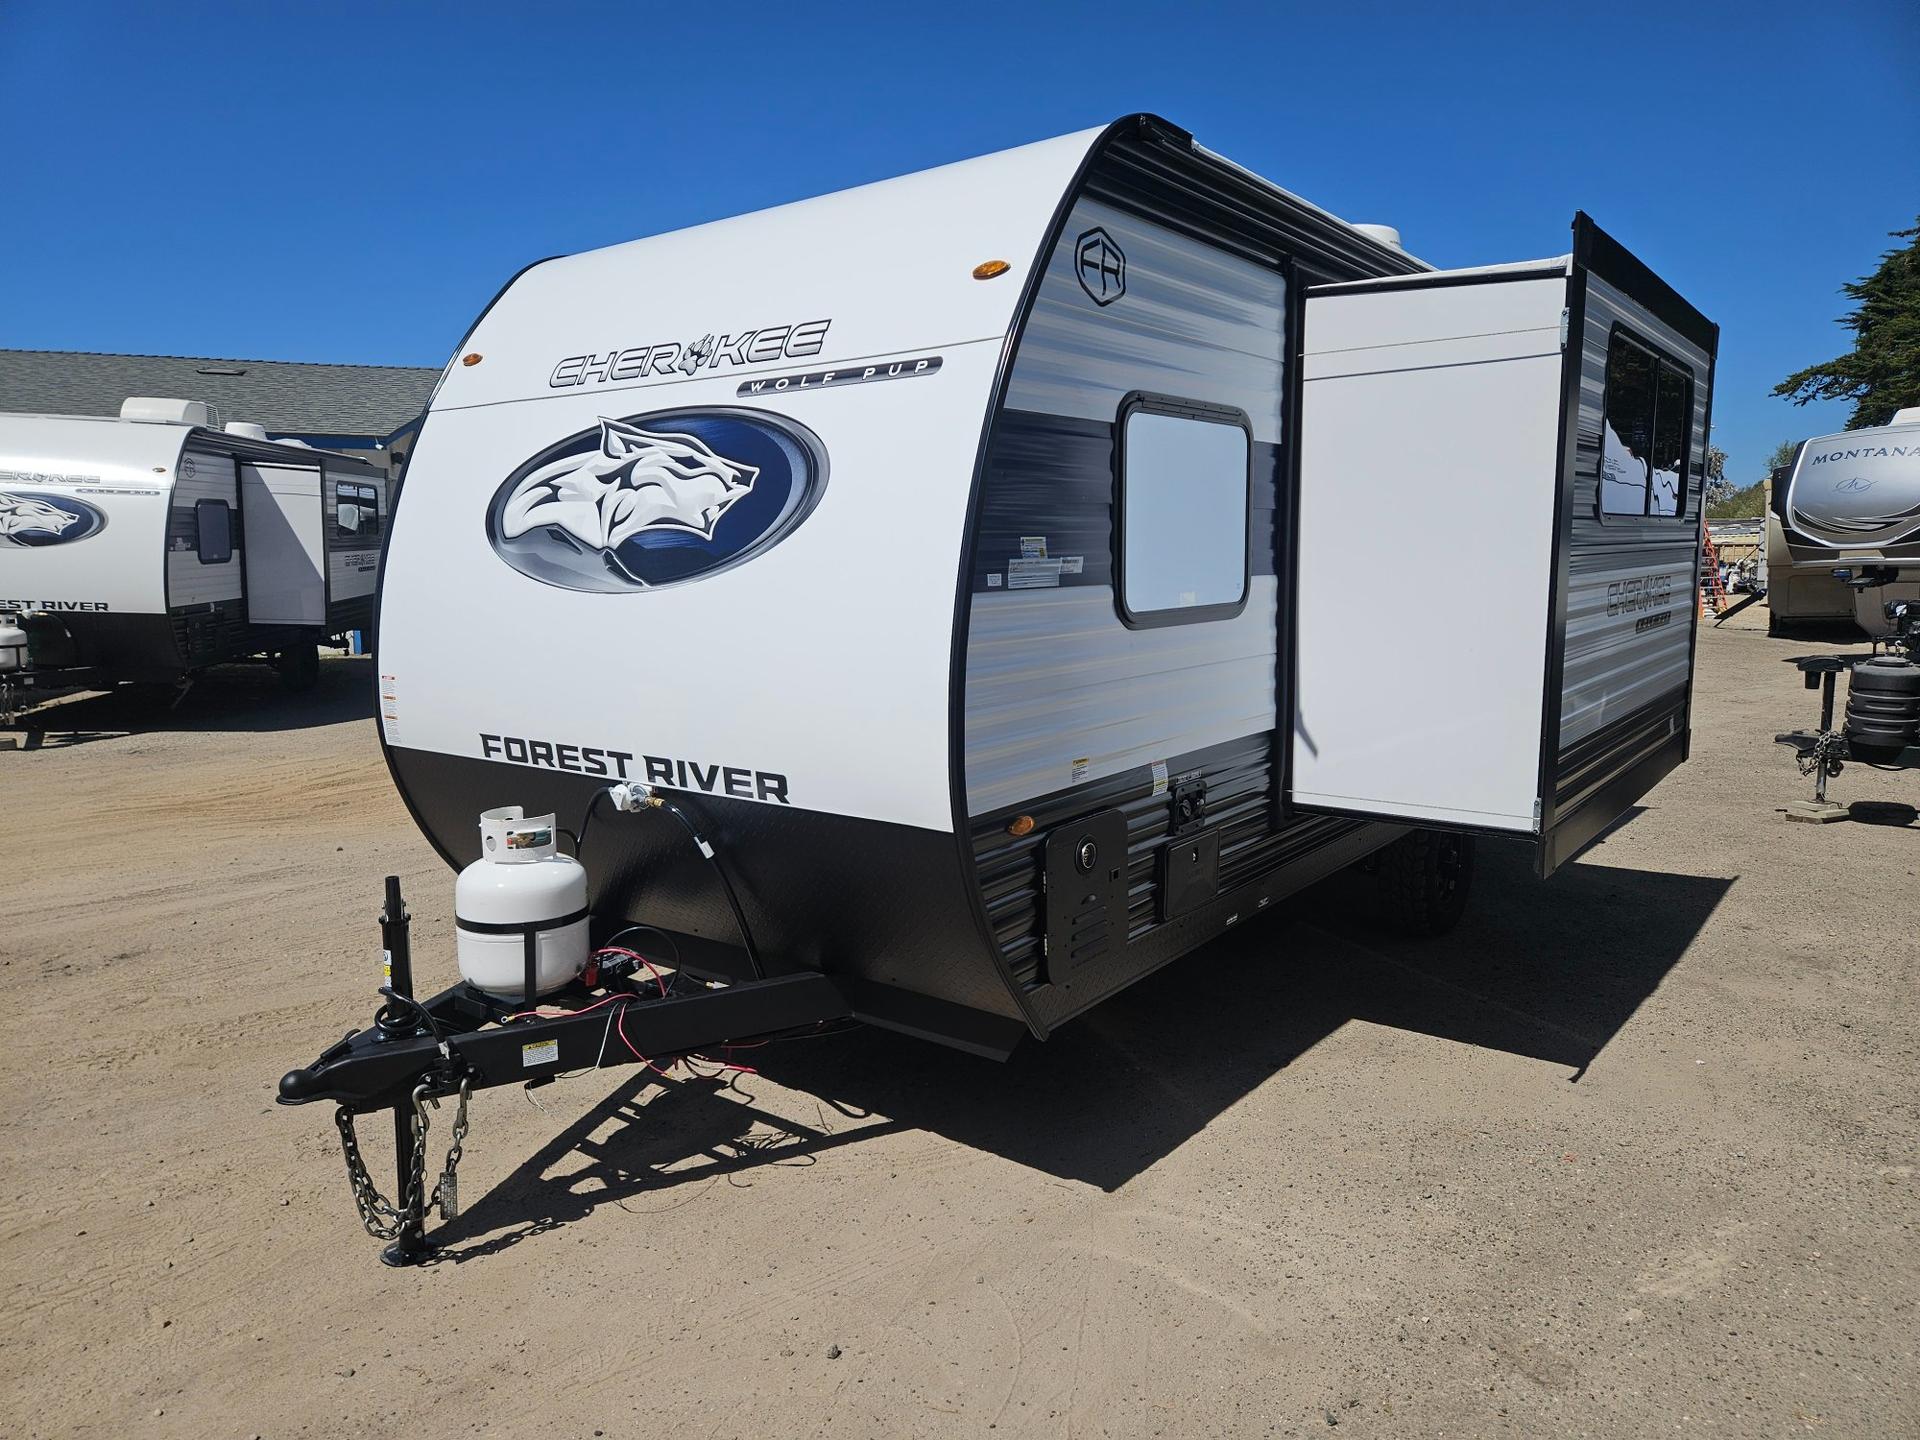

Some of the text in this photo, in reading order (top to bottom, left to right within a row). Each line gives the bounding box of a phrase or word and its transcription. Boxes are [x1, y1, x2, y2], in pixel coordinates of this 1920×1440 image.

[549, 318, 832, 388] CHEROKEE
[750, 359, 930, 394] WOLF PUP
[1812, 446, 1920, 465] MONTANA
[41, 601, 109, 611] RIVER
[479, 733, 790, 804] FOREST RIVER
